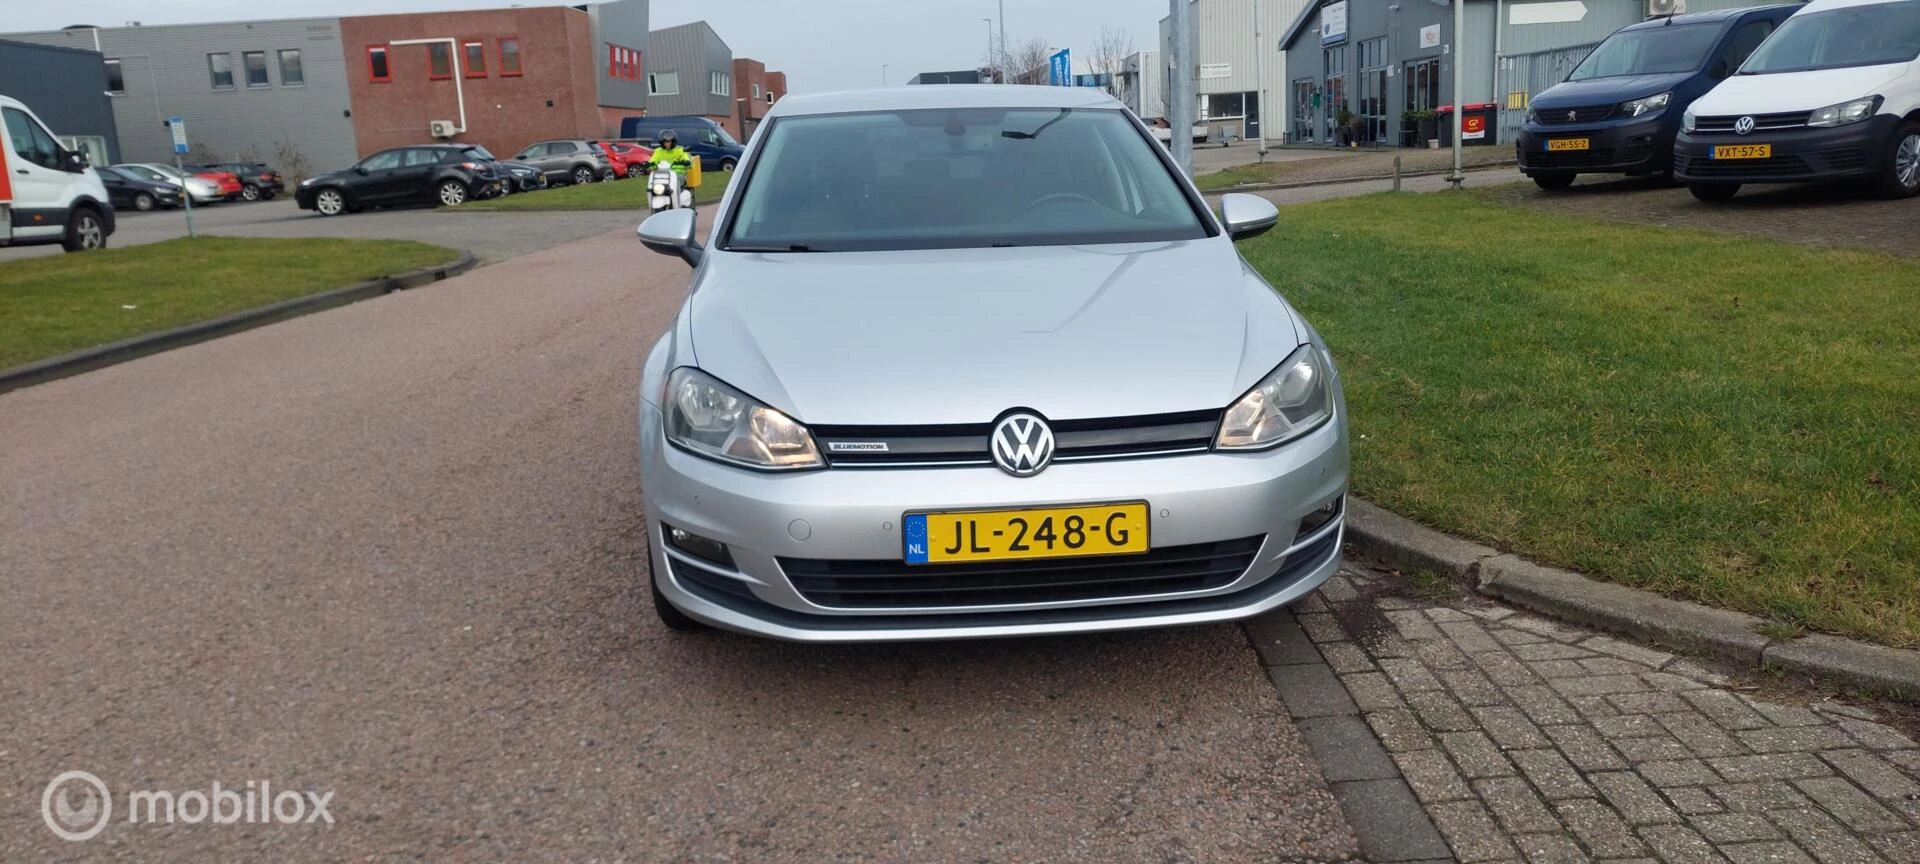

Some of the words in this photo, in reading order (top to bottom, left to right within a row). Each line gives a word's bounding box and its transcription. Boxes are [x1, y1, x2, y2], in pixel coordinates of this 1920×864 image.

[1718, 146, 1765, 157] VXT-57-S
[945, 512, 1129, 554] JL-248-G
[909, 543, 925, 554] NL
